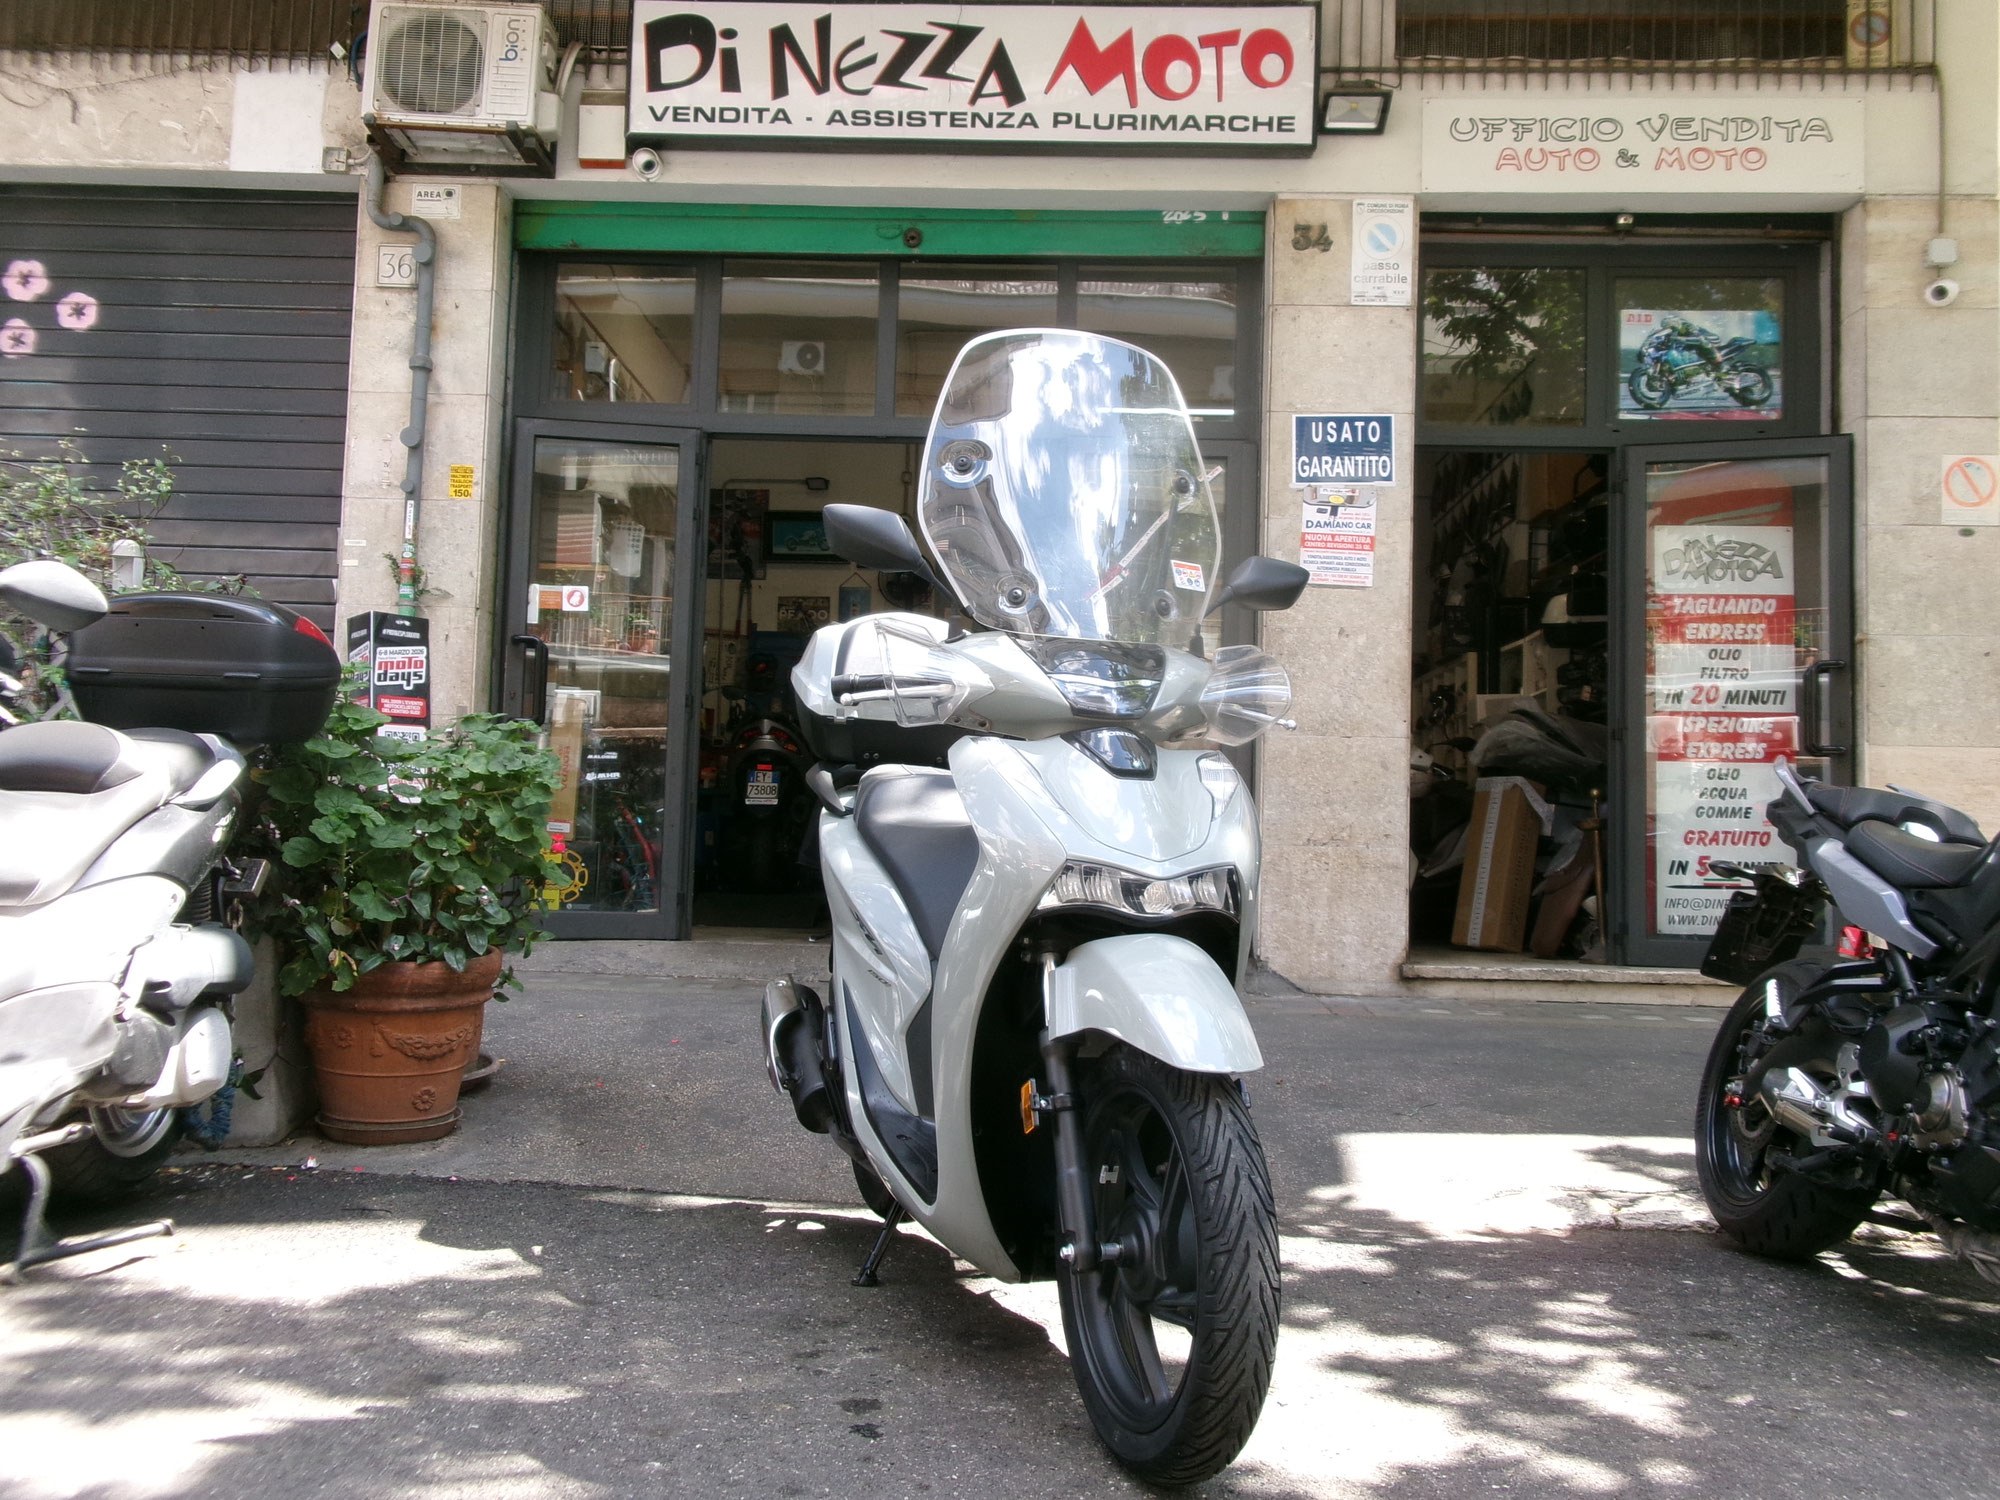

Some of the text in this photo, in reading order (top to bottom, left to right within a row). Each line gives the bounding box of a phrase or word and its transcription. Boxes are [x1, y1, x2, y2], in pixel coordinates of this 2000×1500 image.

[499, 18, 521, 62] bion
[1044, 15, 1295, 109] MOTO
[648, 104, 792, 126] VENDITA
[825, 108, 1039, 131] ASSISTENZA
[1052, 110, 1297, 134] PLURIMARCHE
[1449, 113, 1834, 144] UFFICIO VENDITA
[1495, 146, 1768, 172] AUTO & MOTO
[416, 190, 442, 199] AREA
[381, 253, 412, 279] 36
[1362, 261, 1400, 273] passo
[1353, 273, 1408, 284] carrabile
[1311, 420, 1381, 444] USATO
[1297, 455, 1392, 478] GARANTITO
[1305, 519, 1372, 530] DAMIANO CAR
[1304, 533, 1372, 544] NUOVA APERTURA
[1673, 597, 1777, 616] TAGLIANDO
[1685, 622, 1767, 641] EXPRESS
[1707, 648, 1742, 661] OLIO
[376, 671, 424, 687] days
[1700, 666, 1750, 681] FILTRO
[1664, 683, 1787, 706] IN 20 MINUTI
[1677, 716, 1775, 734] ISPEZIONE
[1685, 741, 1768, 760] EXPRESS
[755, 771, 767, 782] EY
[1706, 767, 1741, 780] OLIO
[748, 785, 777, 796] 73808
[1699, 787, 1748, 801] ACQUA
[1695, 805, 1753, 819] GOMME
[1683, 829, 1771, 847] GRATUITO
[1668, 855, 1711, 877] IN 5
